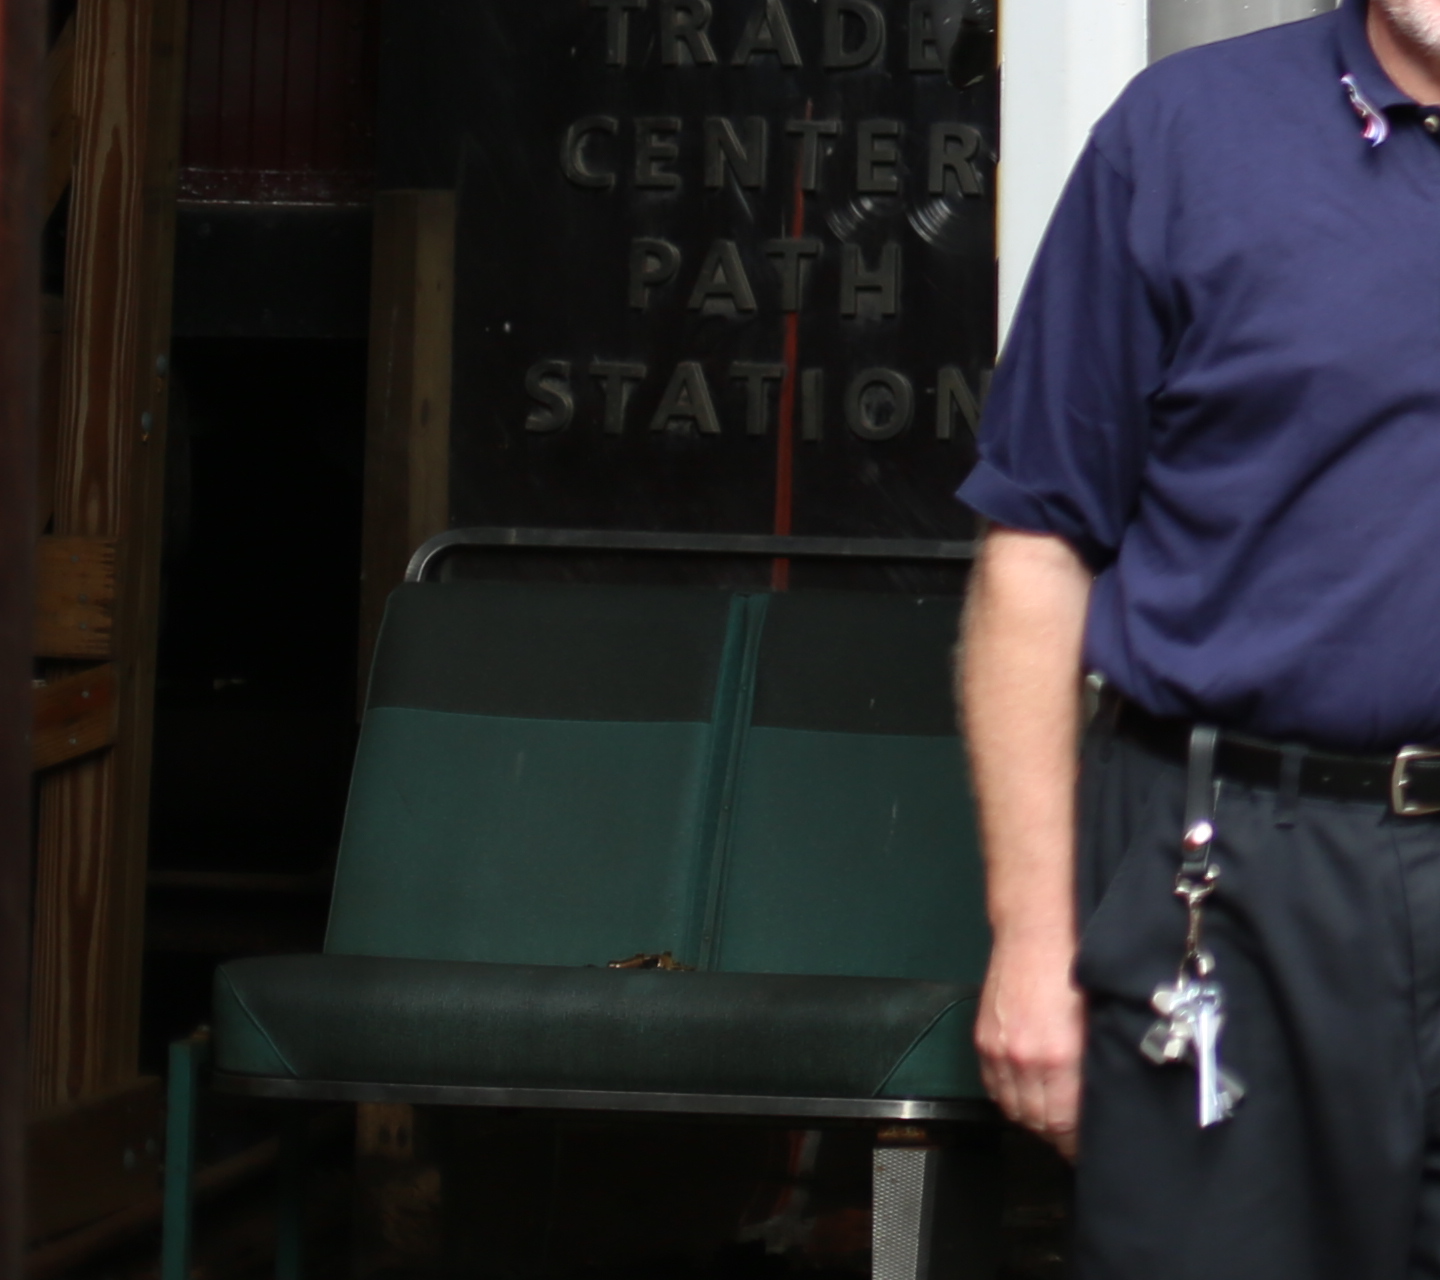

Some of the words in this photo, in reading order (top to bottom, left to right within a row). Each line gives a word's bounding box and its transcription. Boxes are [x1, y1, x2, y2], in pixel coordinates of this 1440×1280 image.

[560, 118, 991, 203] CENTER
[629, 243, 907, 326] PATH
[524, 367, 997, 453] STATION
